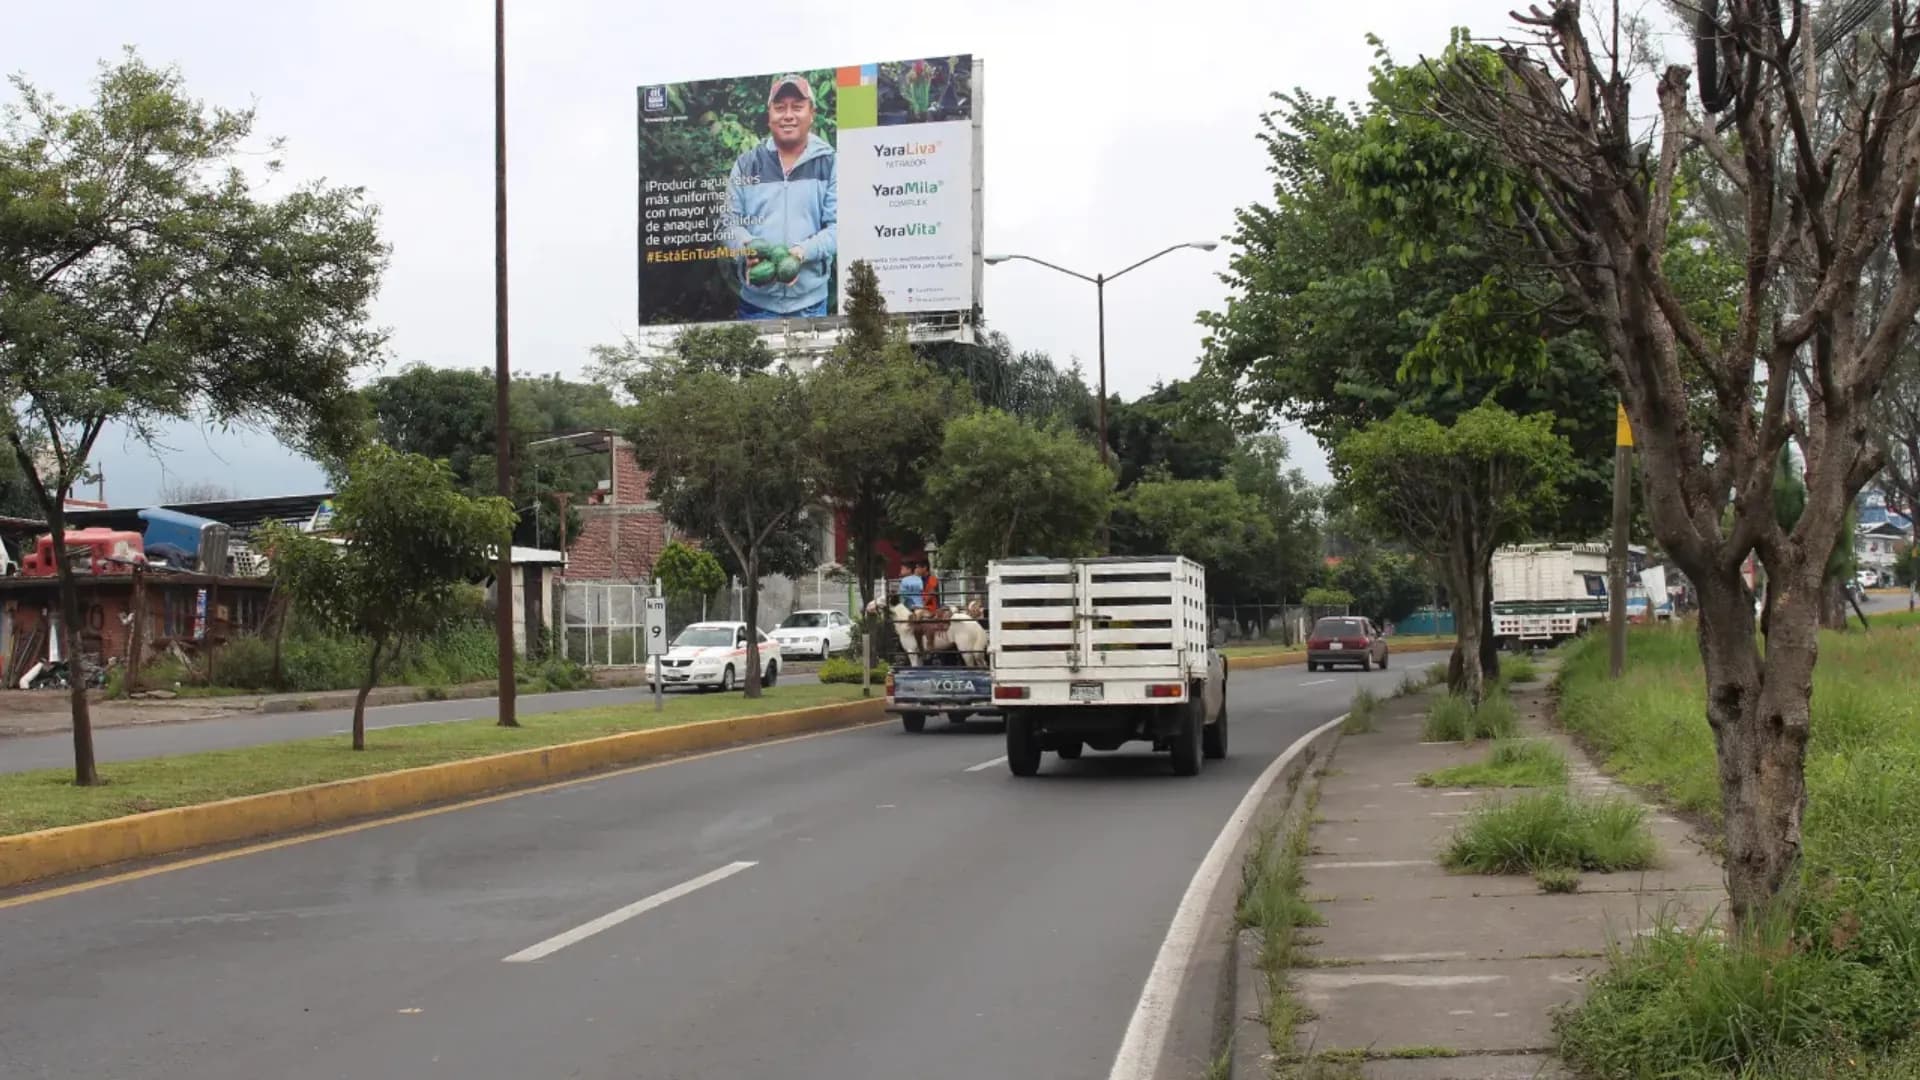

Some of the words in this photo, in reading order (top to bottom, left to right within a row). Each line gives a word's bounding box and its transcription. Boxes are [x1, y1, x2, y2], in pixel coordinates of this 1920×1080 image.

[645, 193, 669, 205] más
[645, 209, 666, 219] con
[669, 206, 705, 218] mayor
[645, 221, 660, 232] de
[663, 217, 709, 232] anaquel
[645, 234, 660, 246] de
[647, 601, 664, 609] km
[651, 625, 661, 638] 9
